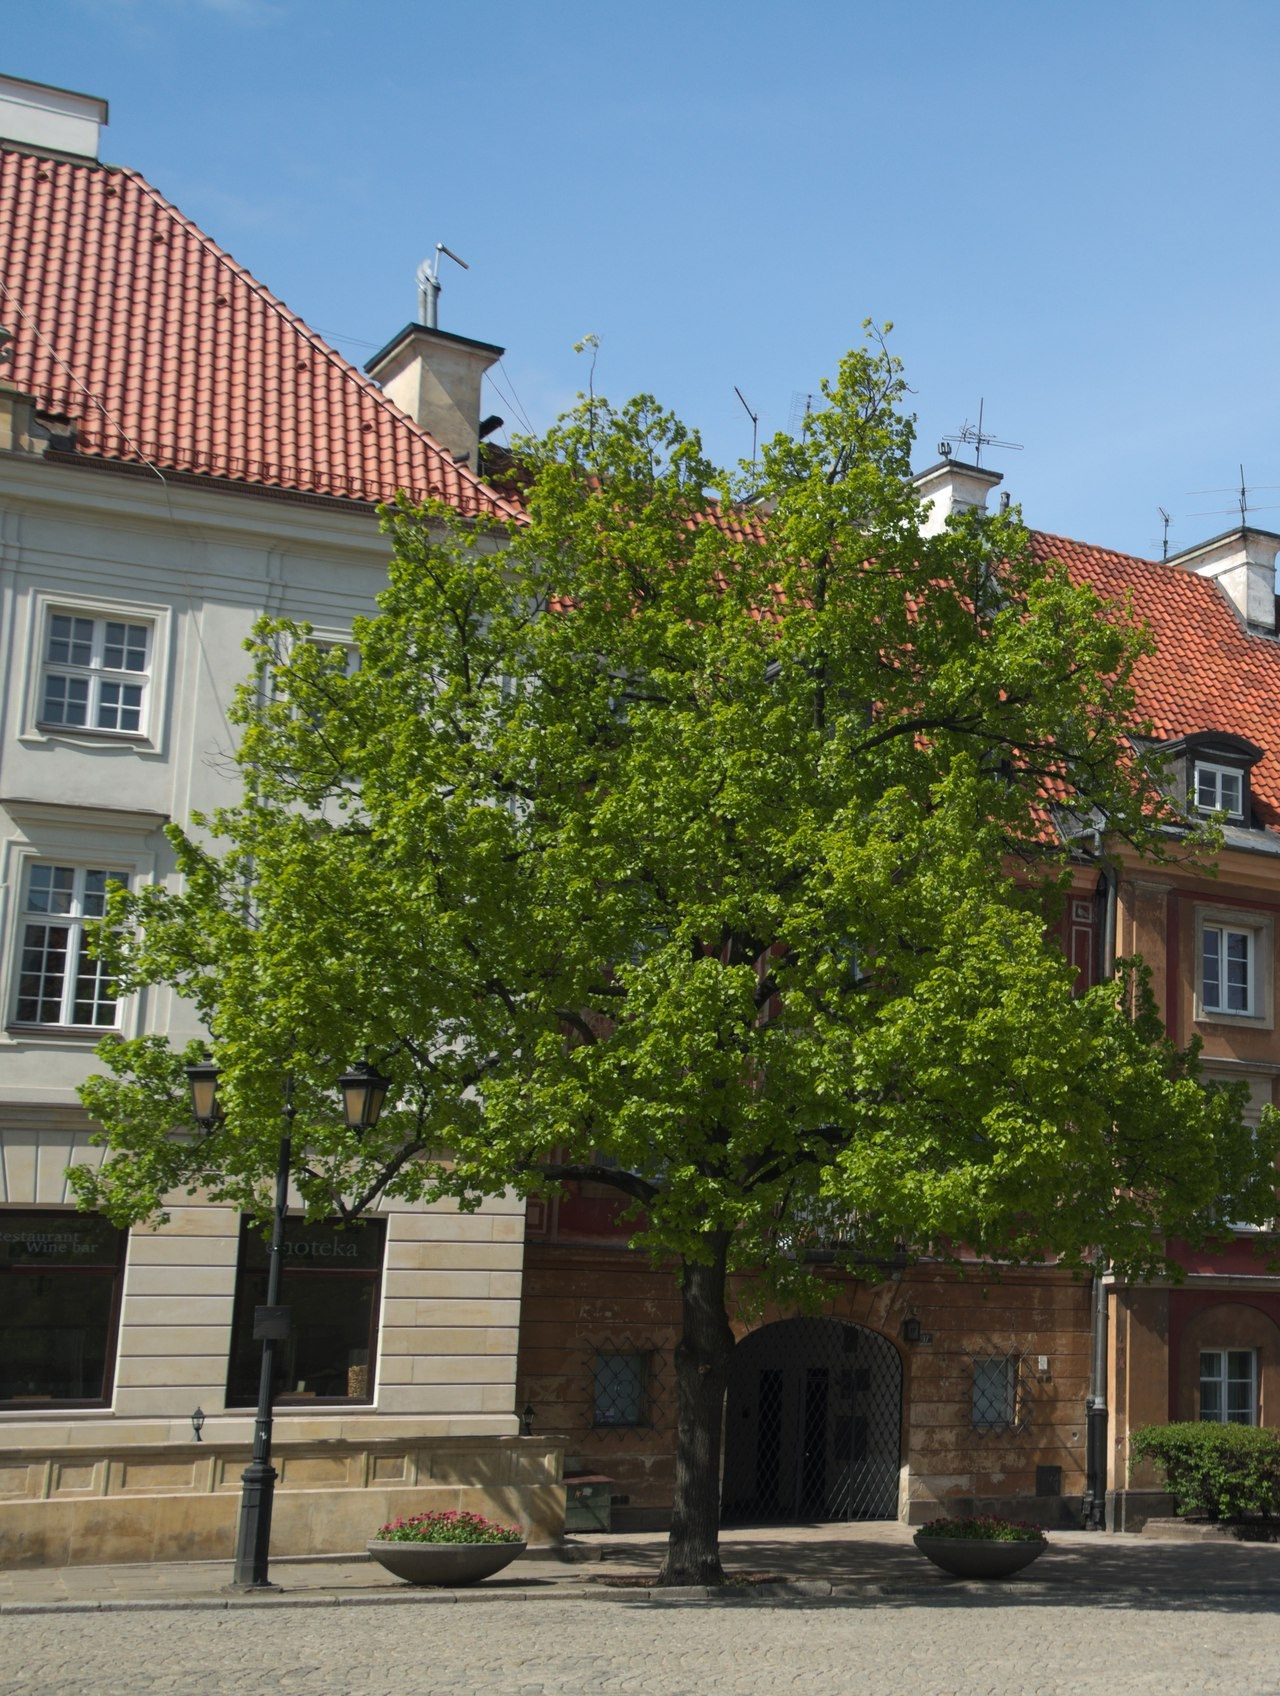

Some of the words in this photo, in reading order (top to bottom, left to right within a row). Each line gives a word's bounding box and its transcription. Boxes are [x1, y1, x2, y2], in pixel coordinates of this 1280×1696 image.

[0, 1231, 80, 1242] estaurant
[26, 1241, 67, 1253] Wine
[72, 1241, 98, 1253] bar
